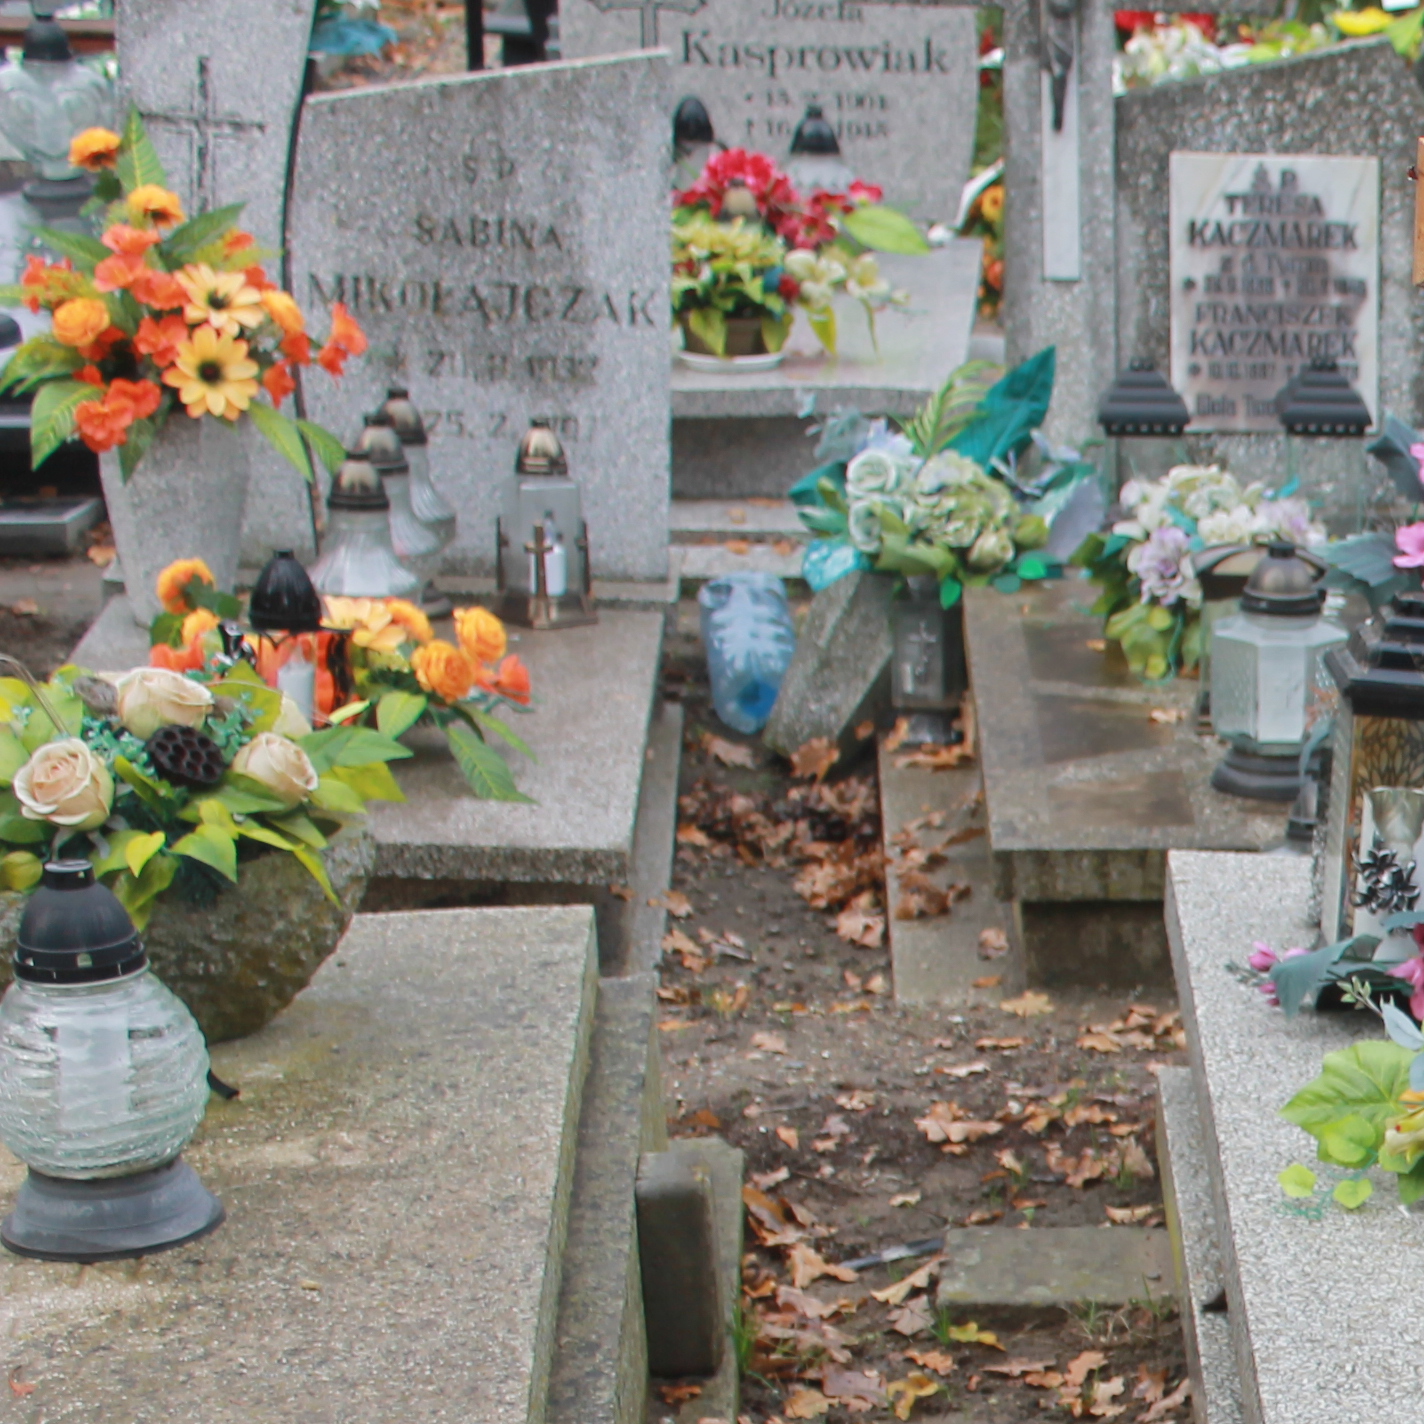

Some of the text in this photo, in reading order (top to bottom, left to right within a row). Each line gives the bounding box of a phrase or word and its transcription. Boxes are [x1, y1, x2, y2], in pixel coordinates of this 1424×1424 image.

[681, 29, 951, 78] Kasprowiak
[414, 212, 565, 252] SABINA
[1188, 219, 1359, 250] KACZMAREK
[1189, 328, 1359, 357] KACZMAREK
